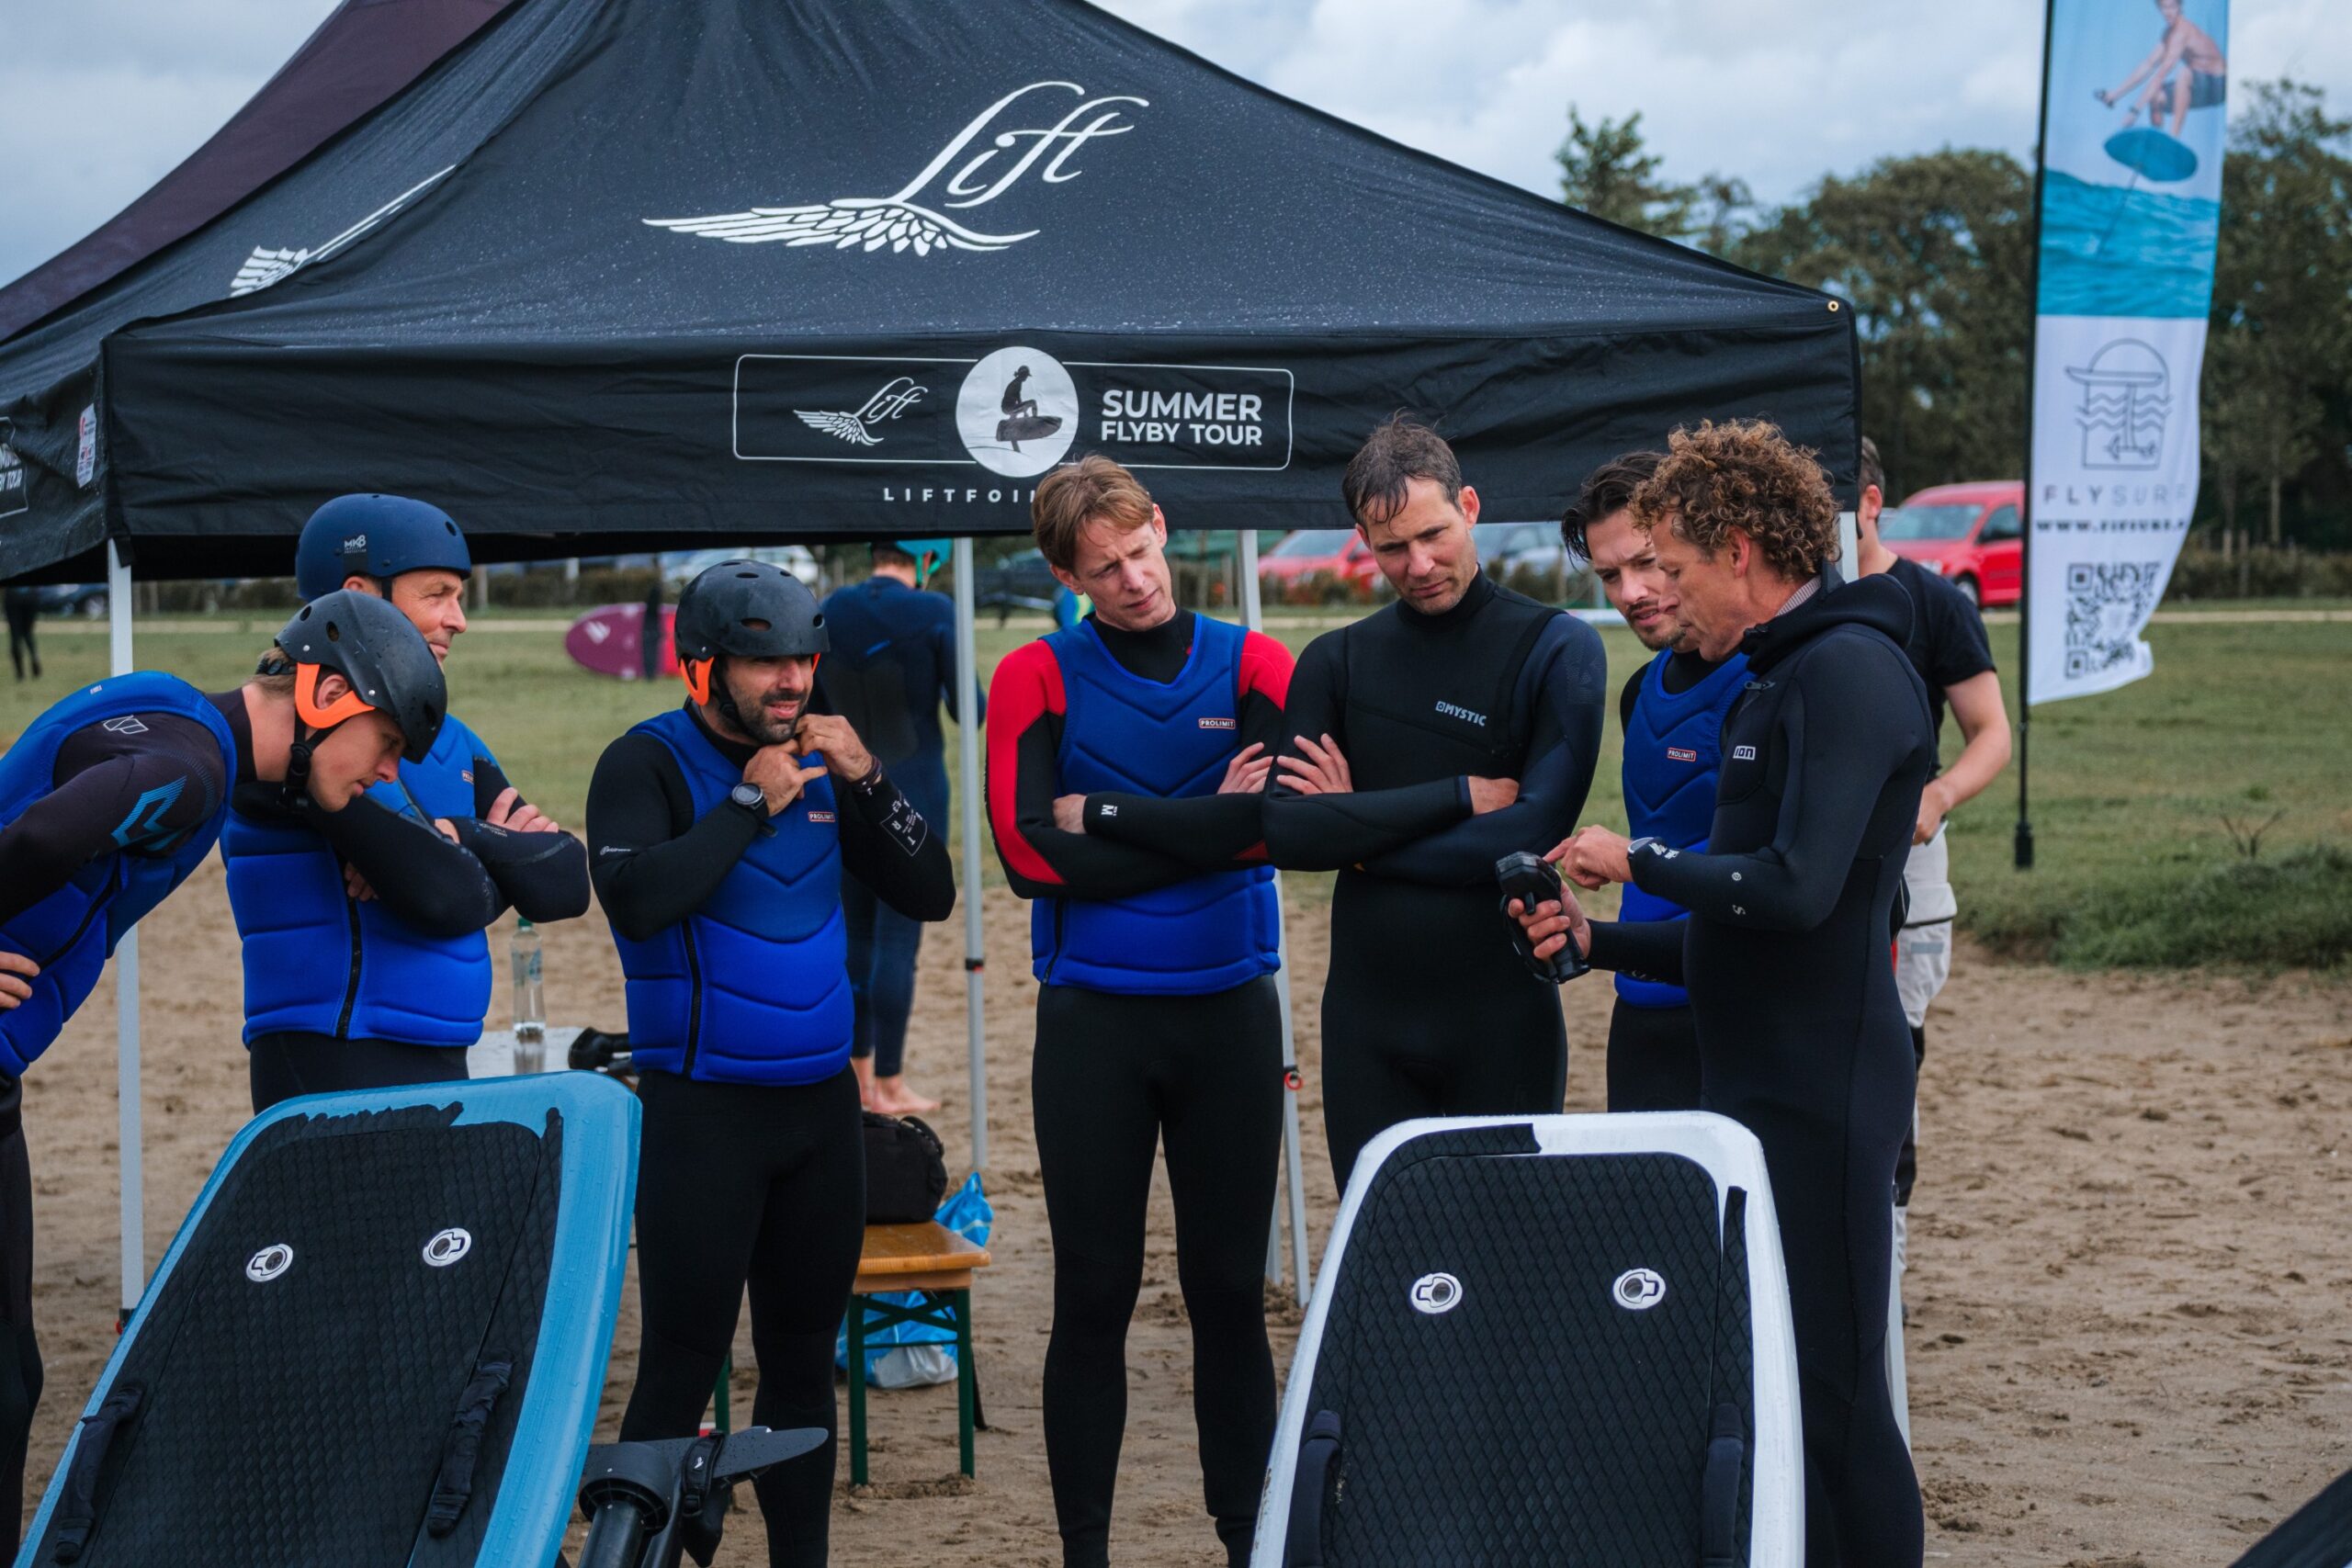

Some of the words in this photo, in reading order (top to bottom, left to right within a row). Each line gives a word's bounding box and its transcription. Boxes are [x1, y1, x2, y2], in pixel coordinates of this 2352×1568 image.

[1102, 389, 1262, 422] SUMMER
[1102, 421, 1181, 443] FLYBY
[1189, 423, 1262, 446] TOUR
[1200, 719, 1235, 728] PROLIMIT
[1444, 704, 1487, 727] MYSTIC
